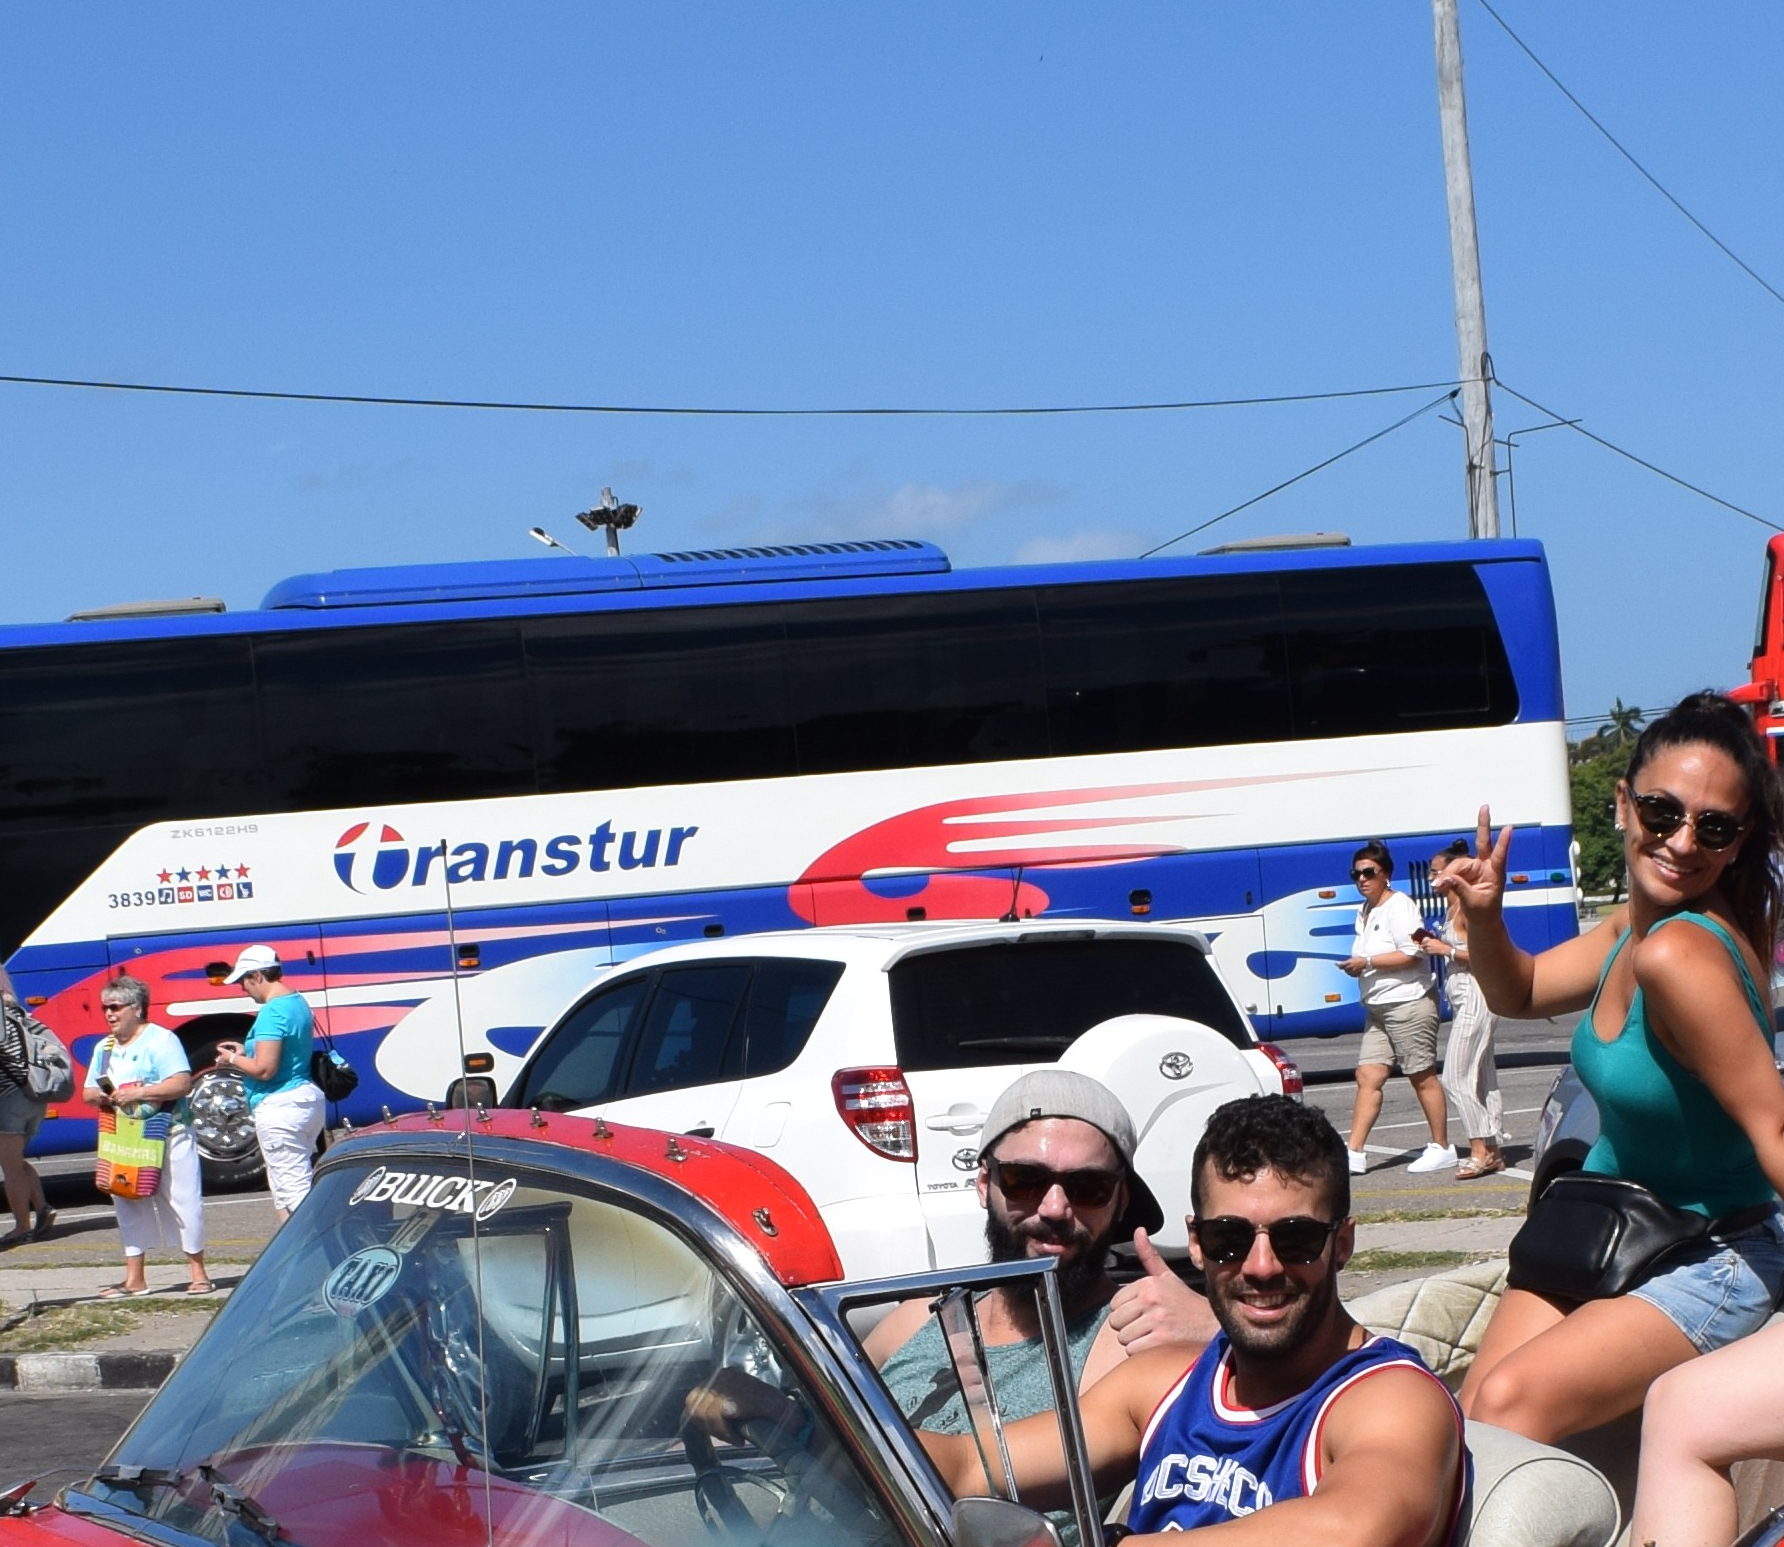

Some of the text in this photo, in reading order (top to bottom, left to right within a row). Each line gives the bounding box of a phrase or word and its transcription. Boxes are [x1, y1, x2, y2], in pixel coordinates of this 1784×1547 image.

[170, 823, 259, 839] ZK6122H9
[107, 890, 156, 909] 3839
[364, 1171, 495, 1213] BUICK
